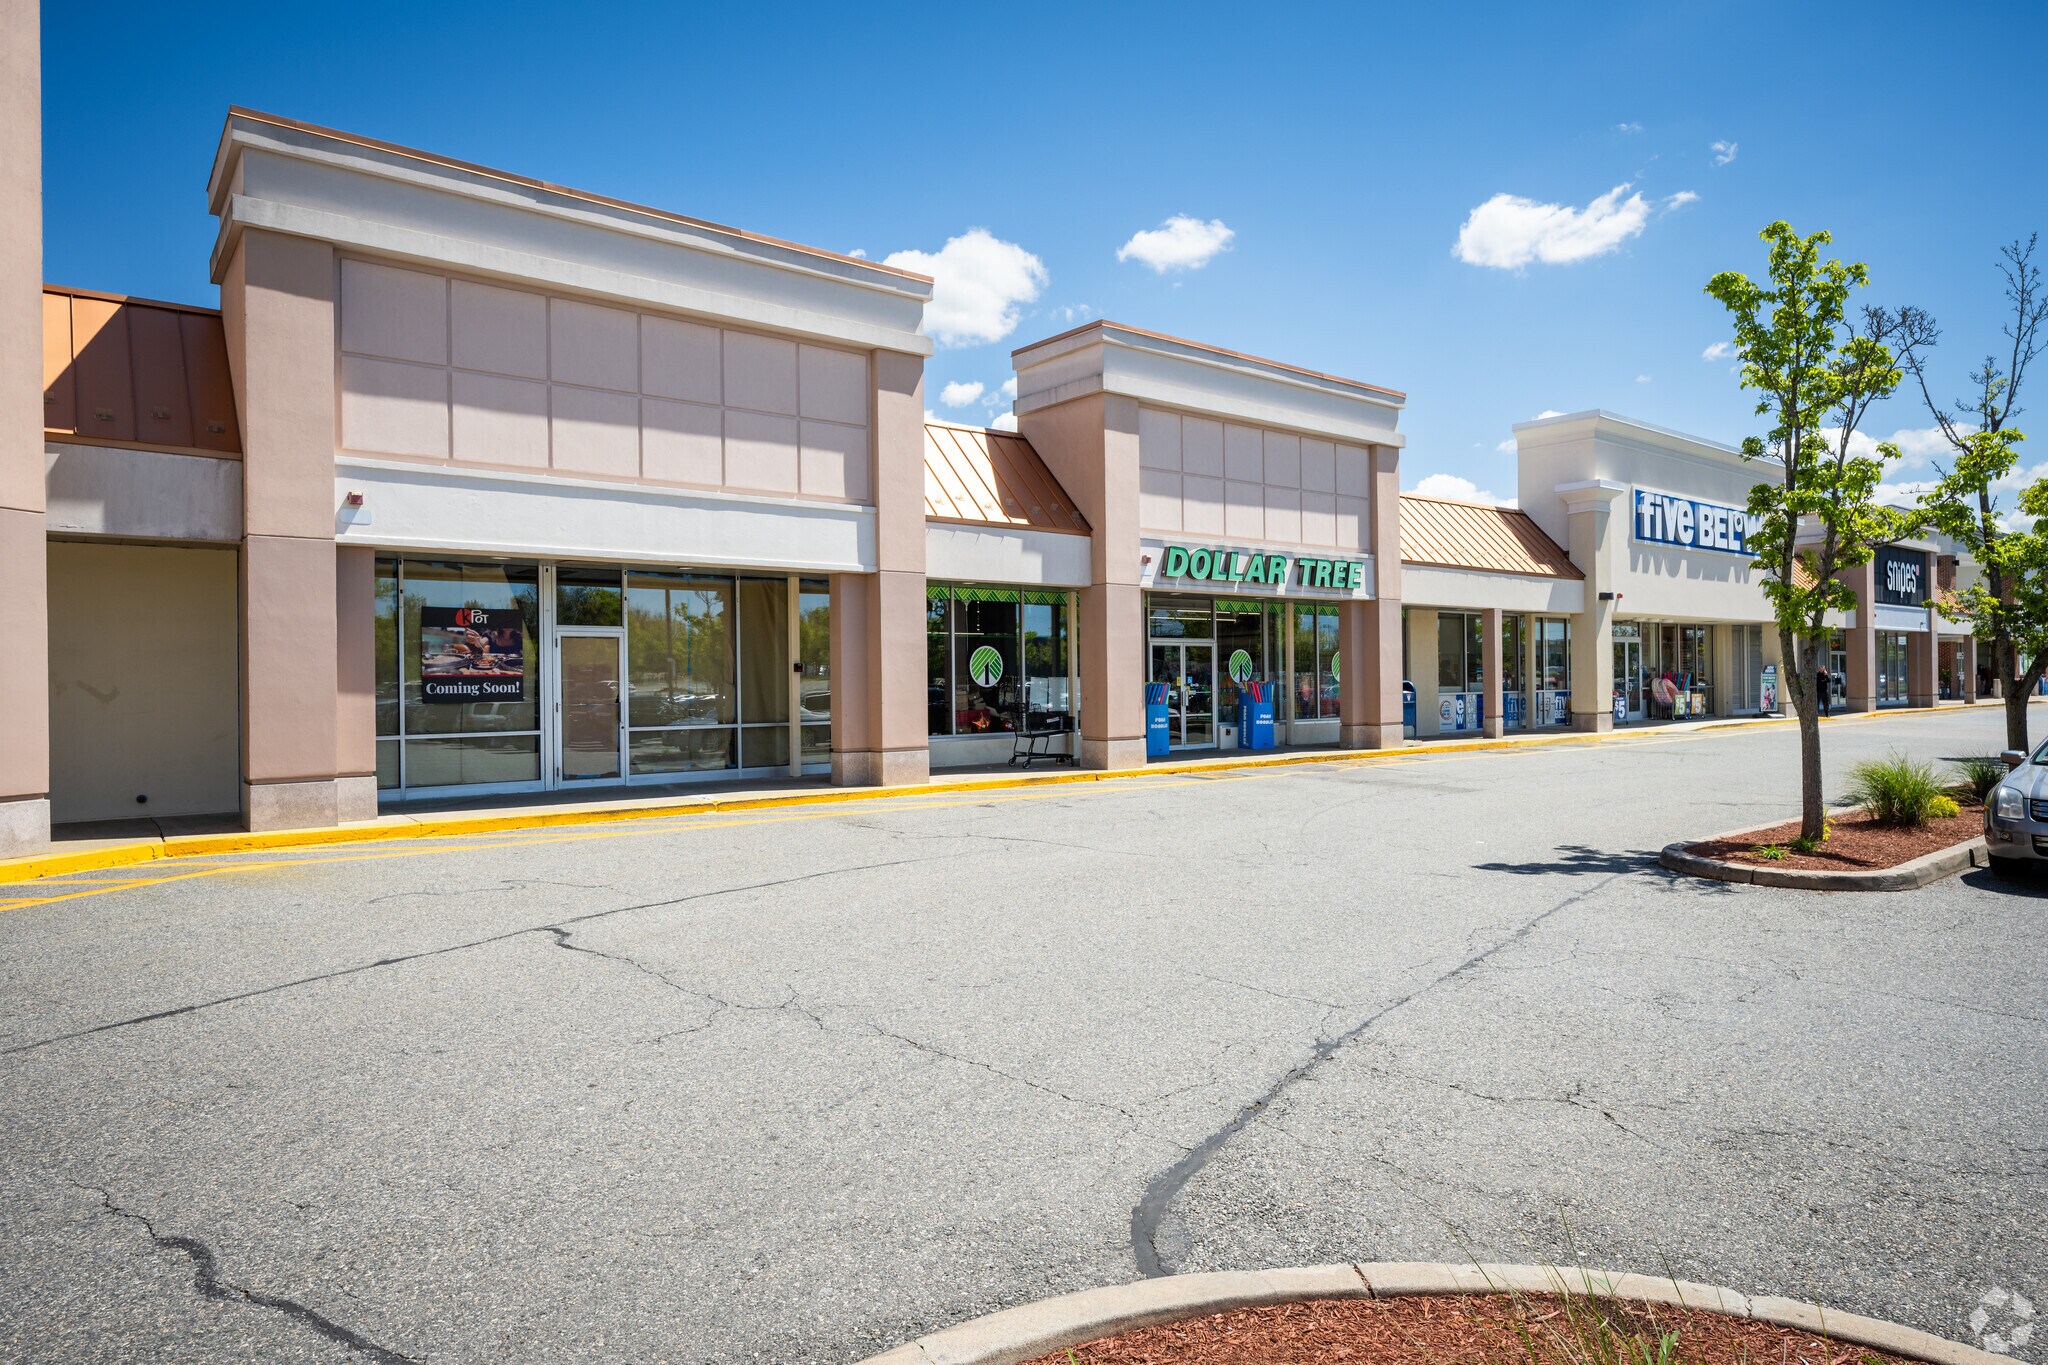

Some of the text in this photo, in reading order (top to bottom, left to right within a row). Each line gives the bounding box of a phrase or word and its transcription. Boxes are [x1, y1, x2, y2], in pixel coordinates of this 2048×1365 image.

[1639, 492, 1694, 544] five
[1164, 546, 1363, 589] DOLLAR TREE
[1887, 560, 1916, 598] snipes
[426, 681, 520, 696] Coming Soon!
[1615, 700, 1625, 719] $5
